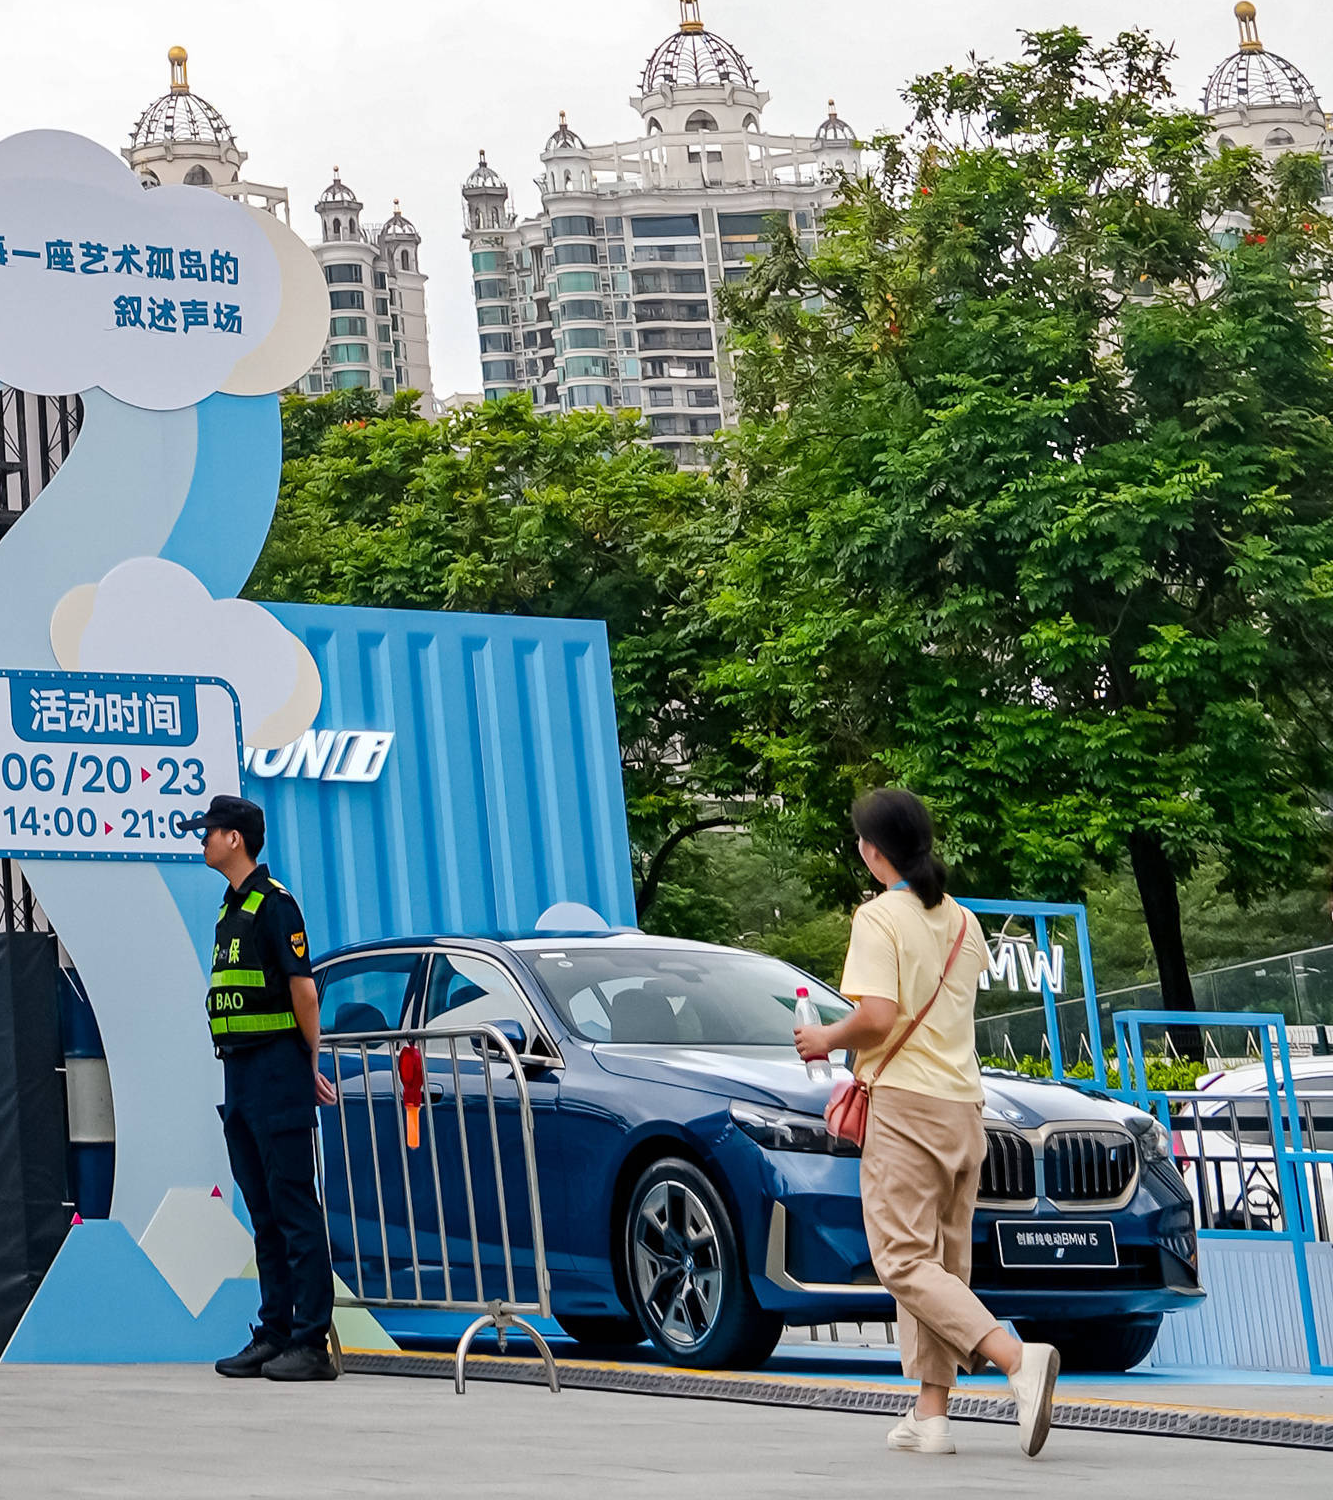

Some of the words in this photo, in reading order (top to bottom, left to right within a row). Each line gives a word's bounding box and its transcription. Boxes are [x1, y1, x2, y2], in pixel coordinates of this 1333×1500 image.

[113, 294, 243, 335] 叙述声场
[30, 688, 182, 736] 活动时间
[157, 757, 207, 796] 23
[3, 805, 97, 838] 14:00
[979, 942, 1064, 993] MW
[216, 992, 244, 1010] BAO
